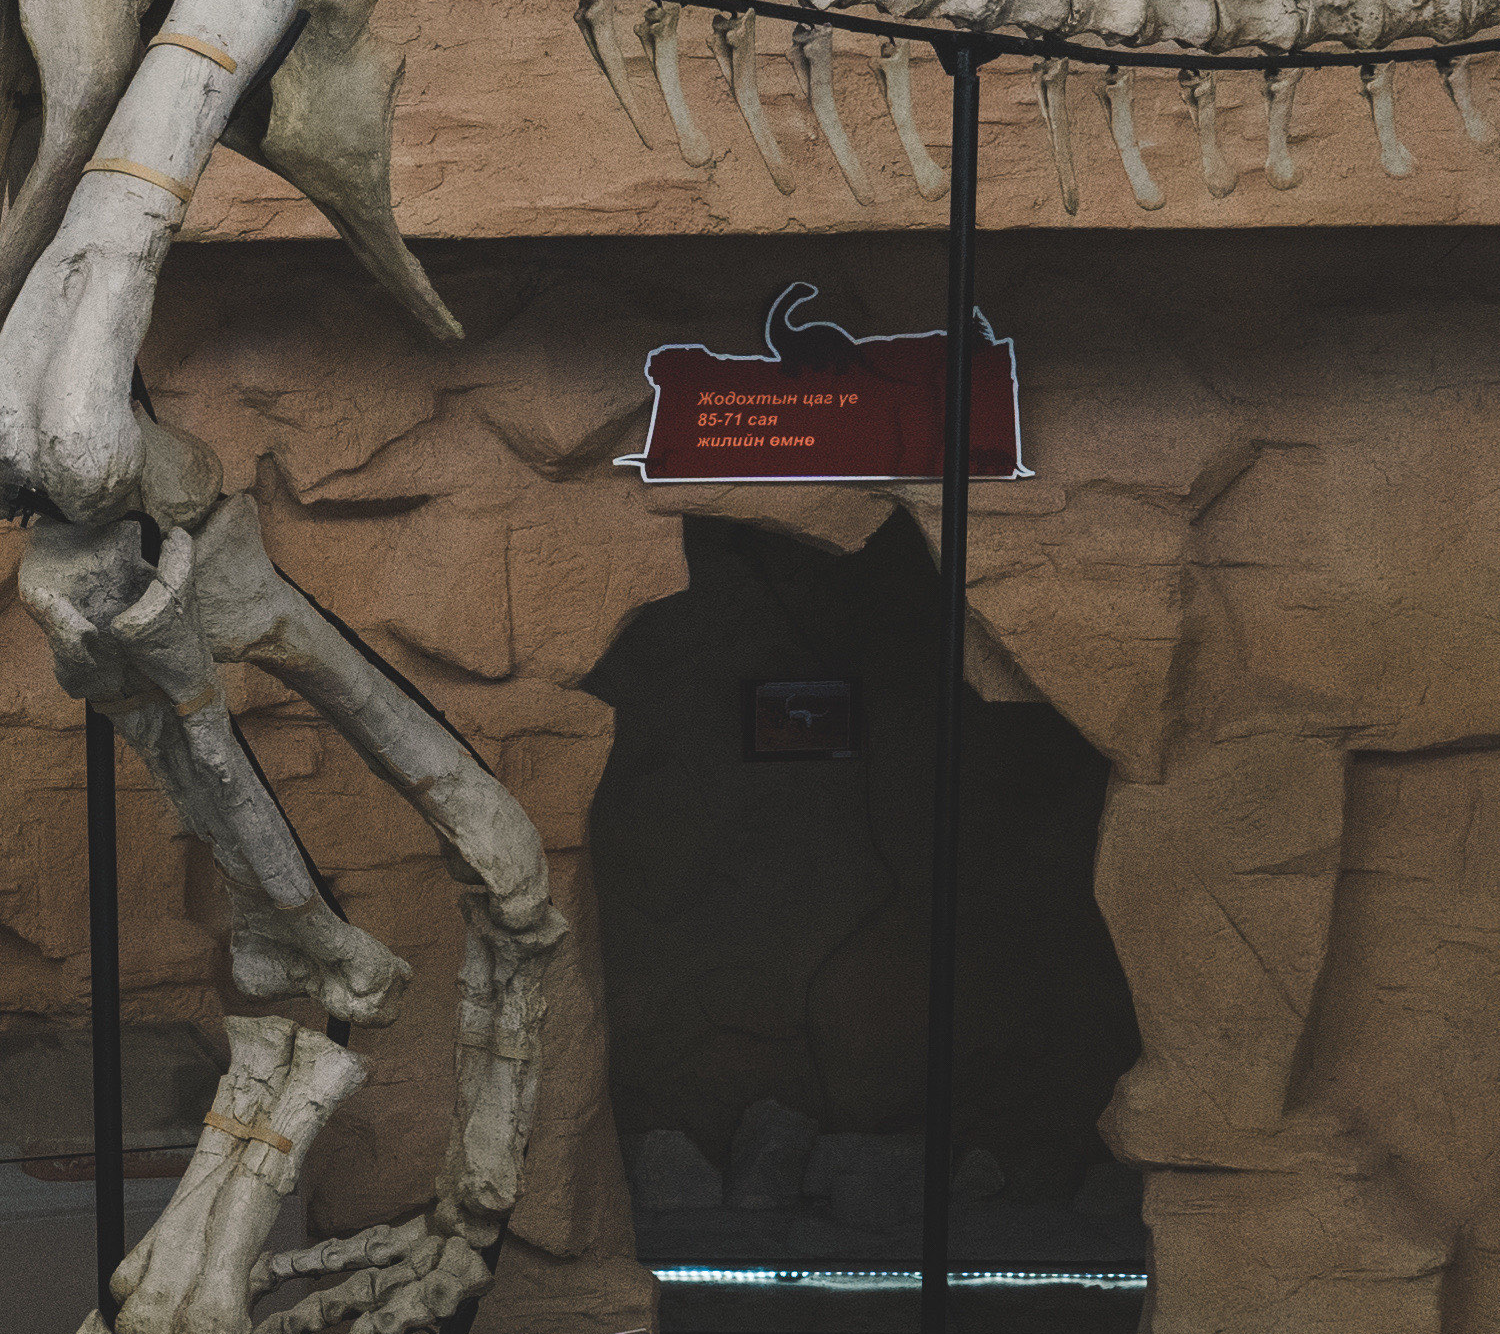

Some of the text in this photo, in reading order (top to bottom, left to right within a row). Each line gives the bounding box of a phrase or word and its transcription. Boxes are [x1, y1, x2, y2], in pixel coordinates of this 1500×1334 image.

[698, 391, 858, 409] Жодохтын цаг үе
[698, 412, 778, 426] 85-71 сая
[697, 433, 815, 447] жилийн өмнө
